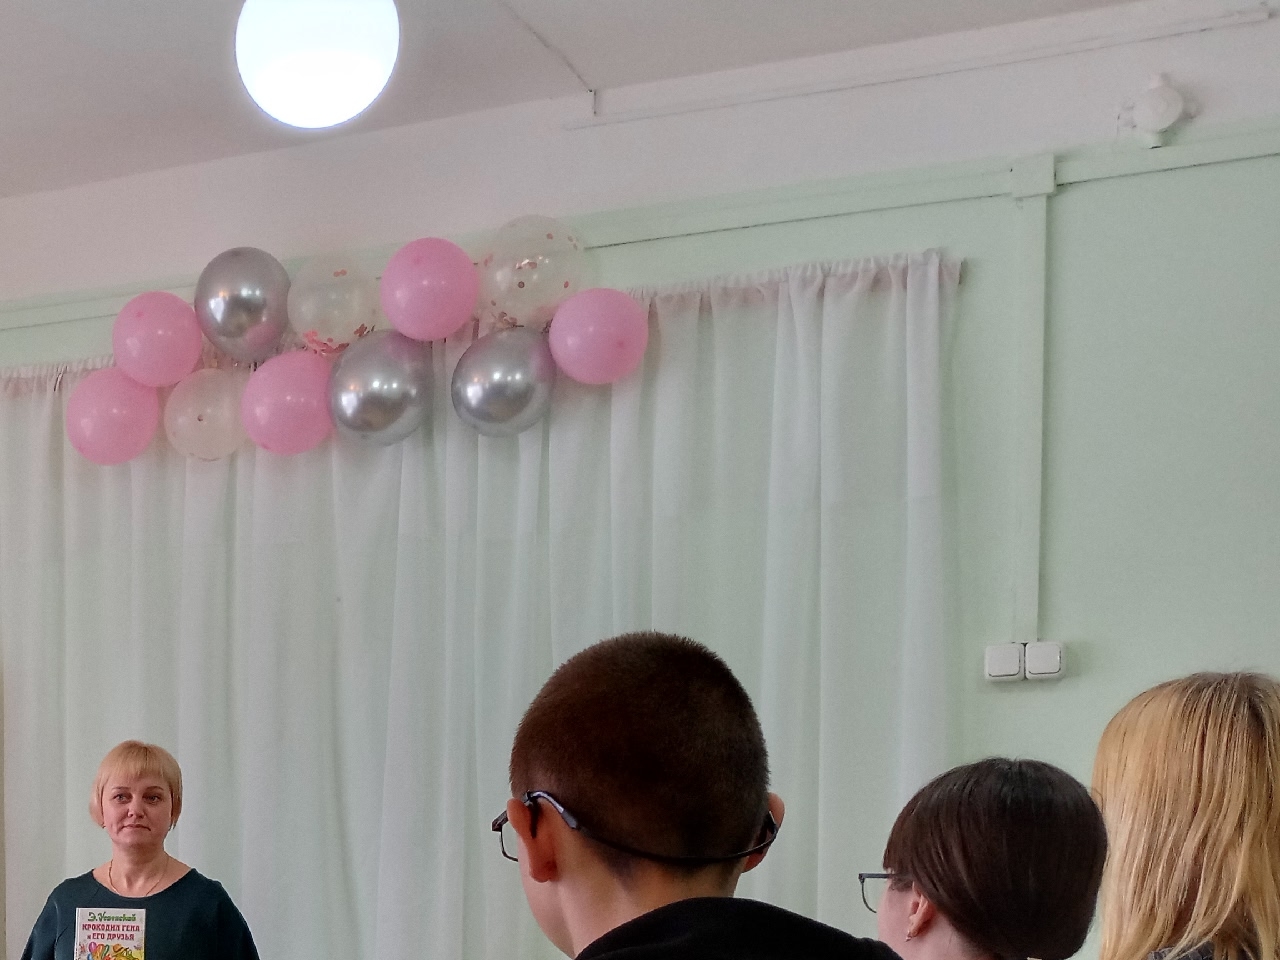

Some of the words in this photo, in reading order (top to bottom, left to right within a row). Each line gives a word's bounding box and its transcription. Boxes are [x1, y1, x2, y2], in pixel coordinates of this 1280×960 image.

[82, 923, 121, 932] КРОКОДИЛ
[121, 924, 140, 932] ГЕНА
[92, 932, 105, 940] ЕГО
[106, 933, 135, 941] ДРУЗЬЯ
